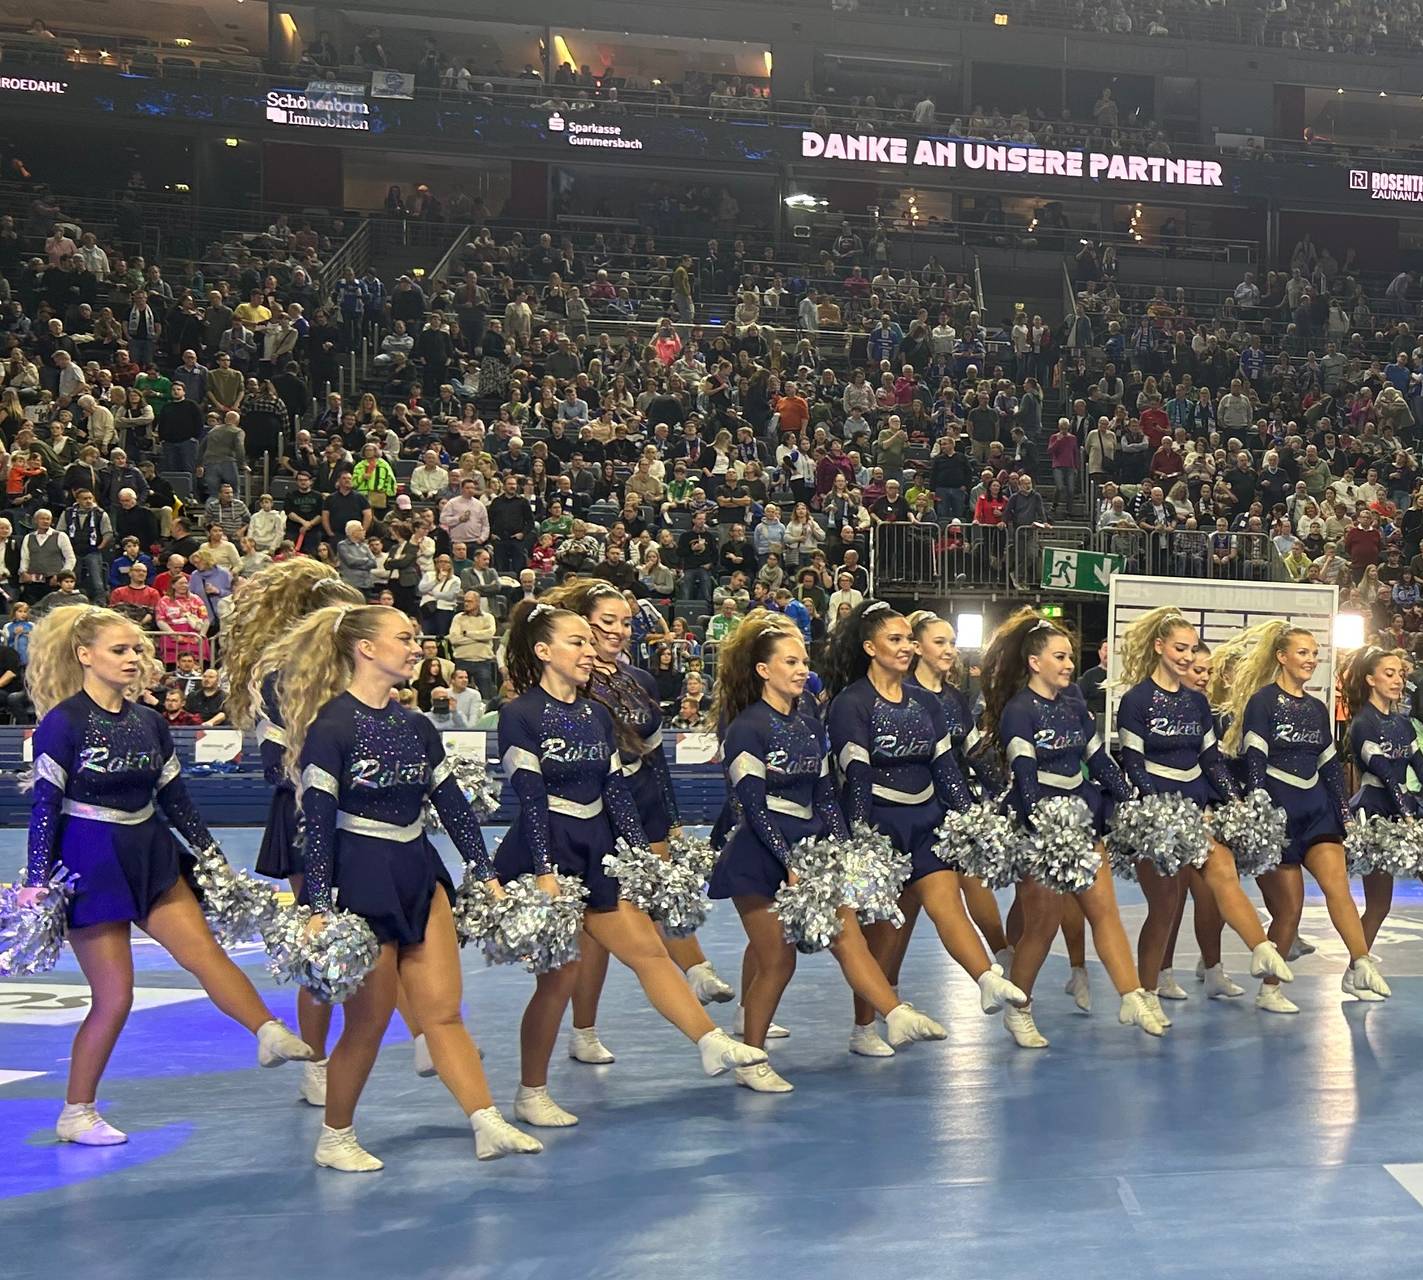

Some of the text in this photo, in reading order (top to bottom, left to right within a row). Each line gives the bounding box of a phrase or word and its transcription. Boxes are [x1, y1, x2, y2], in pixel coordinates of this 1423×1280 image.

[288, 110, 369, 130] Immobilien
[568, 122, 621, 135] Sparkasse
[568, 135, 643, 149] Gummersbach
[802, 131, 1224, 187] DANKE AN UNSERE PARTNER
